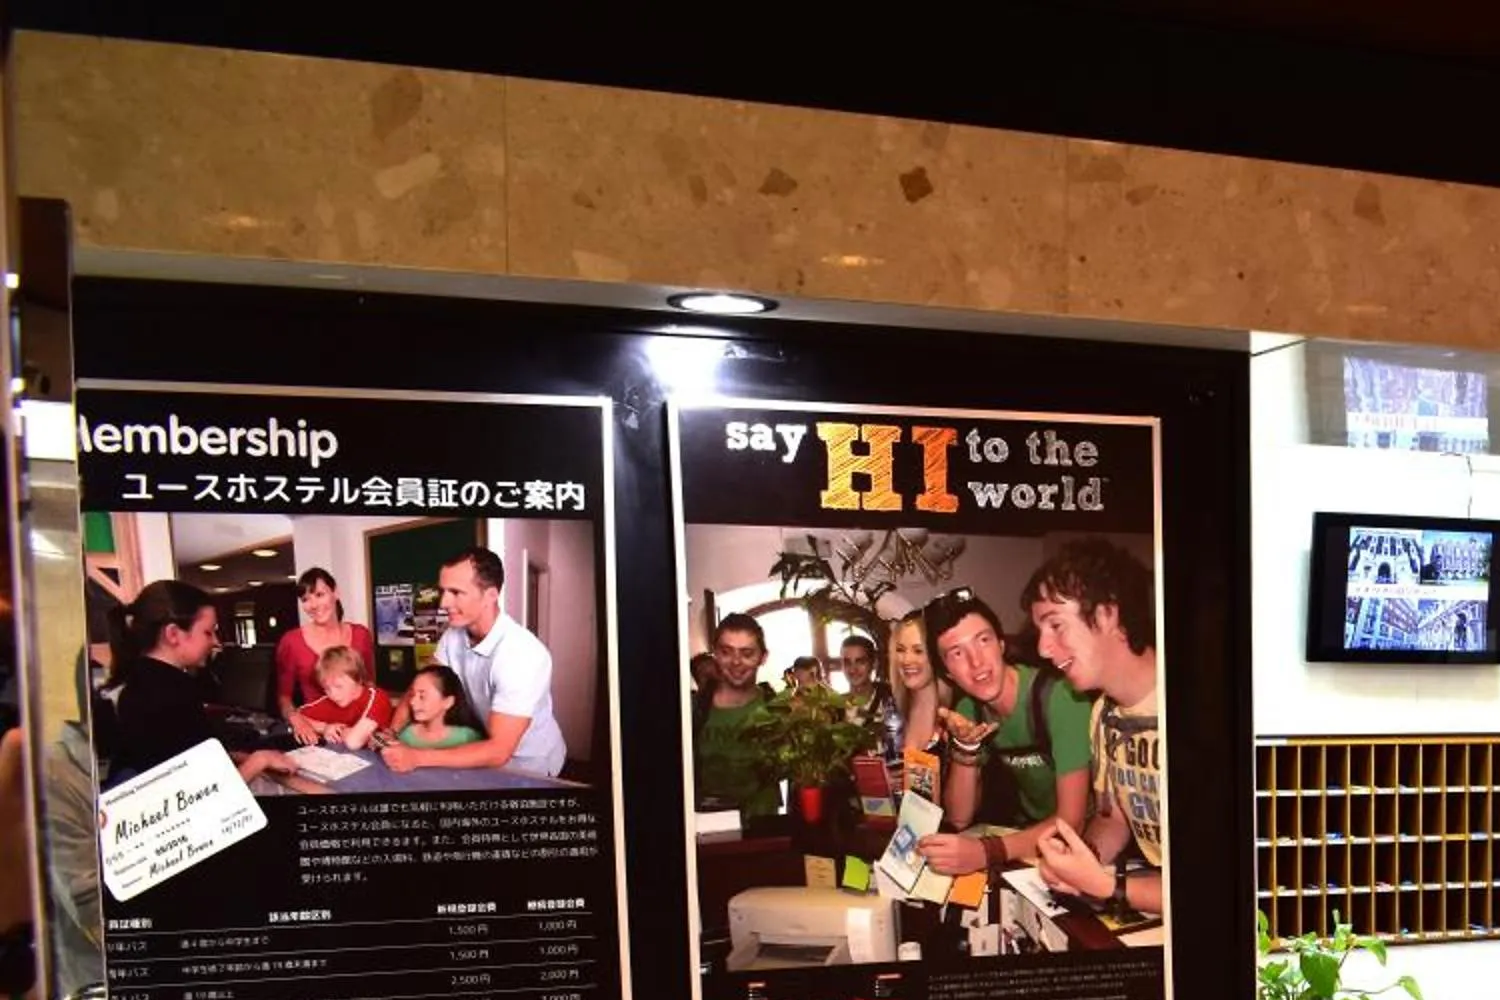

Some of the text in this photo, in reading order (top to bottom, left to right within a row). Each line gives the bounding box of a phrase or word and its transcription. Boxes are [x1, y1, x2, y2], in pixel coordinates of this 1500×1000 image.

[121, 471, 586, 511] ユースホステル会員証のご案内
[725, 420, 1100, 514] say HI to the
[968, 475, 1105, 512] world
[115, 782, 220, 844] Michael Bowen
